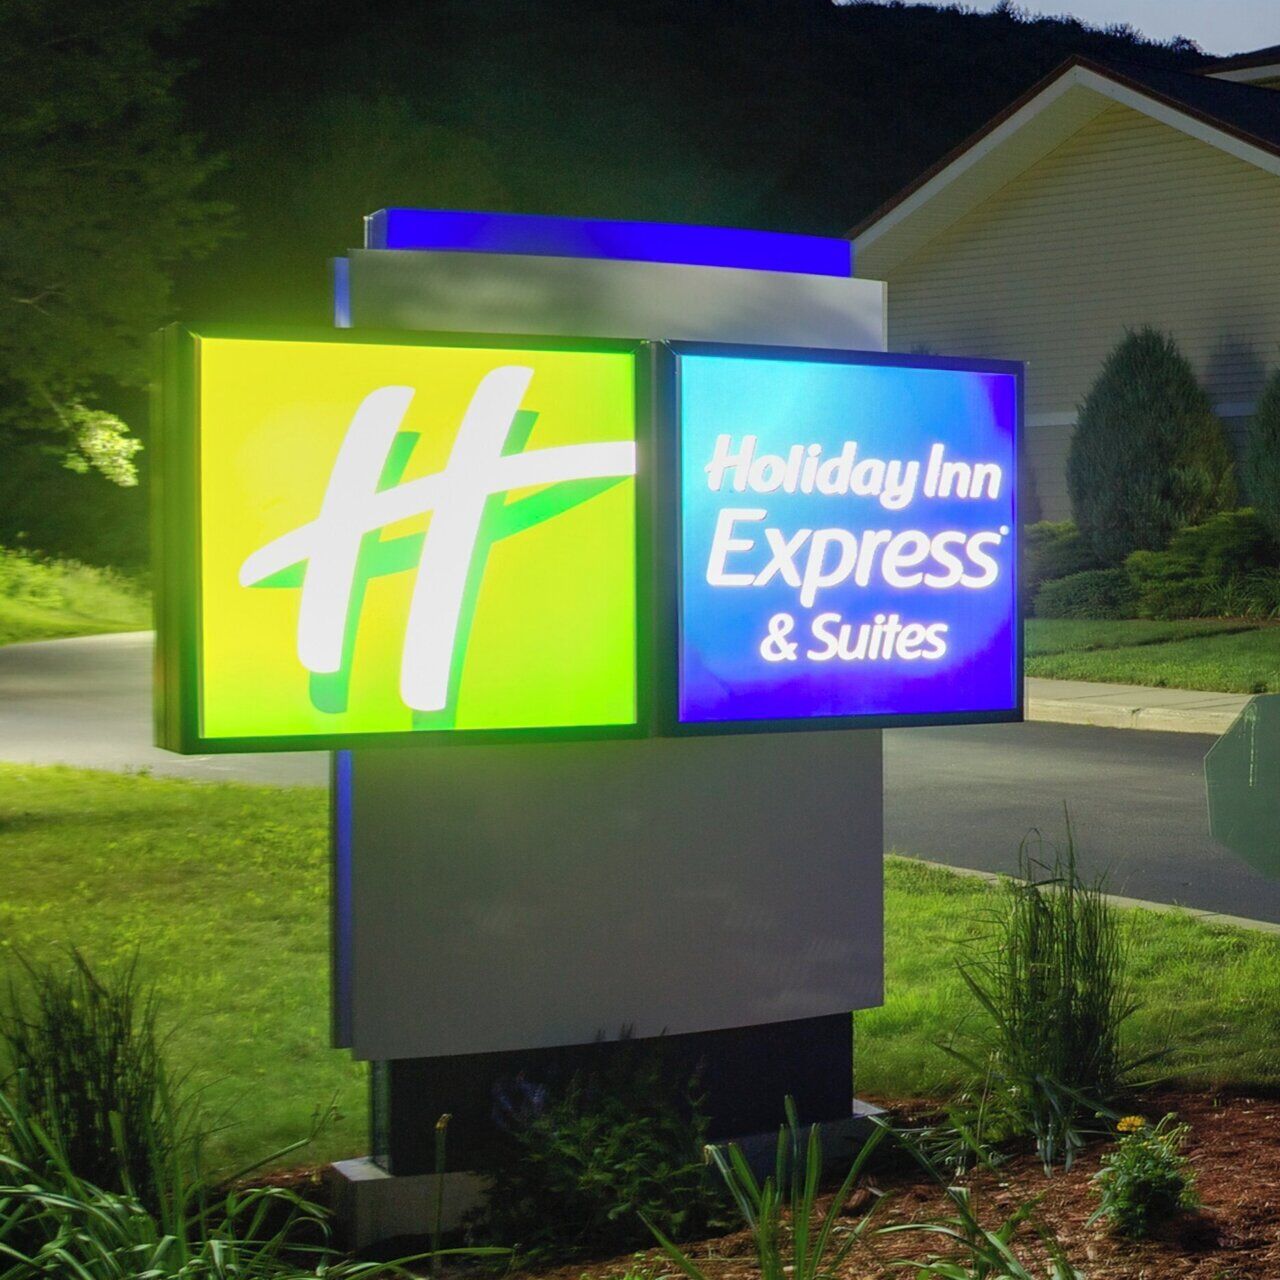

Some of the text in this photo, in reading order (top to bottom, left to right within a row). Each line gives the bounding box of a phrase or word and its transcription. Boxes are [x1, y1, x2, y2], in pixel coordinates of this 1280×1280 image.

[704, 433, 1002, 510] Holiday Inn
[705, 508, 1003, 609] Express
[759, 613, 949, 663] & Suites
